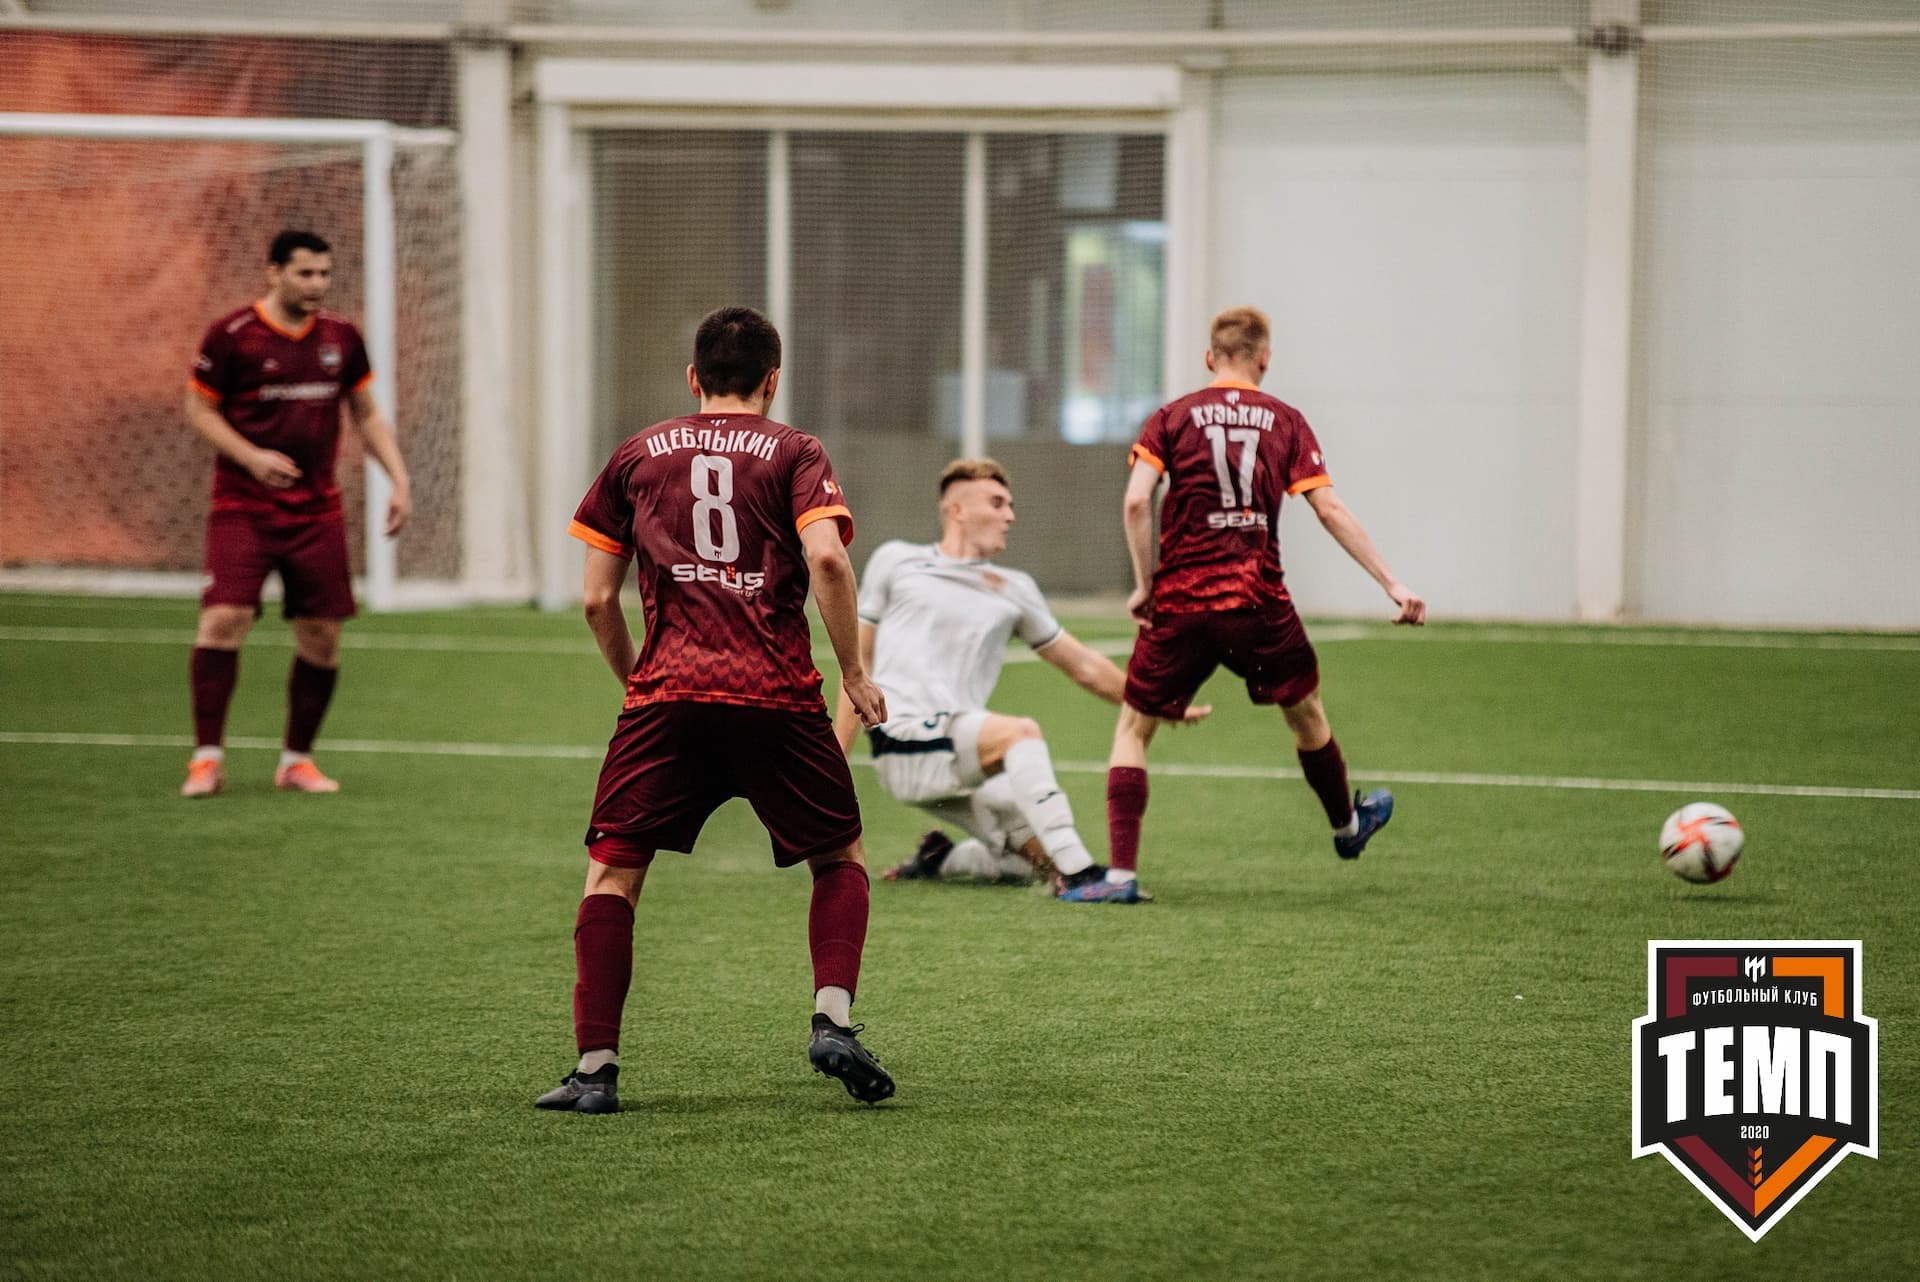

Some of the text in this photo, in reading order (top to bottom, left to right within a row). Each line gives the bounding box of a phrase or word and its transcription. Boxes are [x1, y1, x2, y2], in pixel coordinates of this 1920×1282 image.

[1190, 403, 1275, 432] КУЗЬКИН
[646, 427, 779, 461] ЩЕБЛЫКИН
[1204, 425, 1260, 508] 17
[690, 454, 740, 563] 8
[672, 563, 765, 590] SEUS
